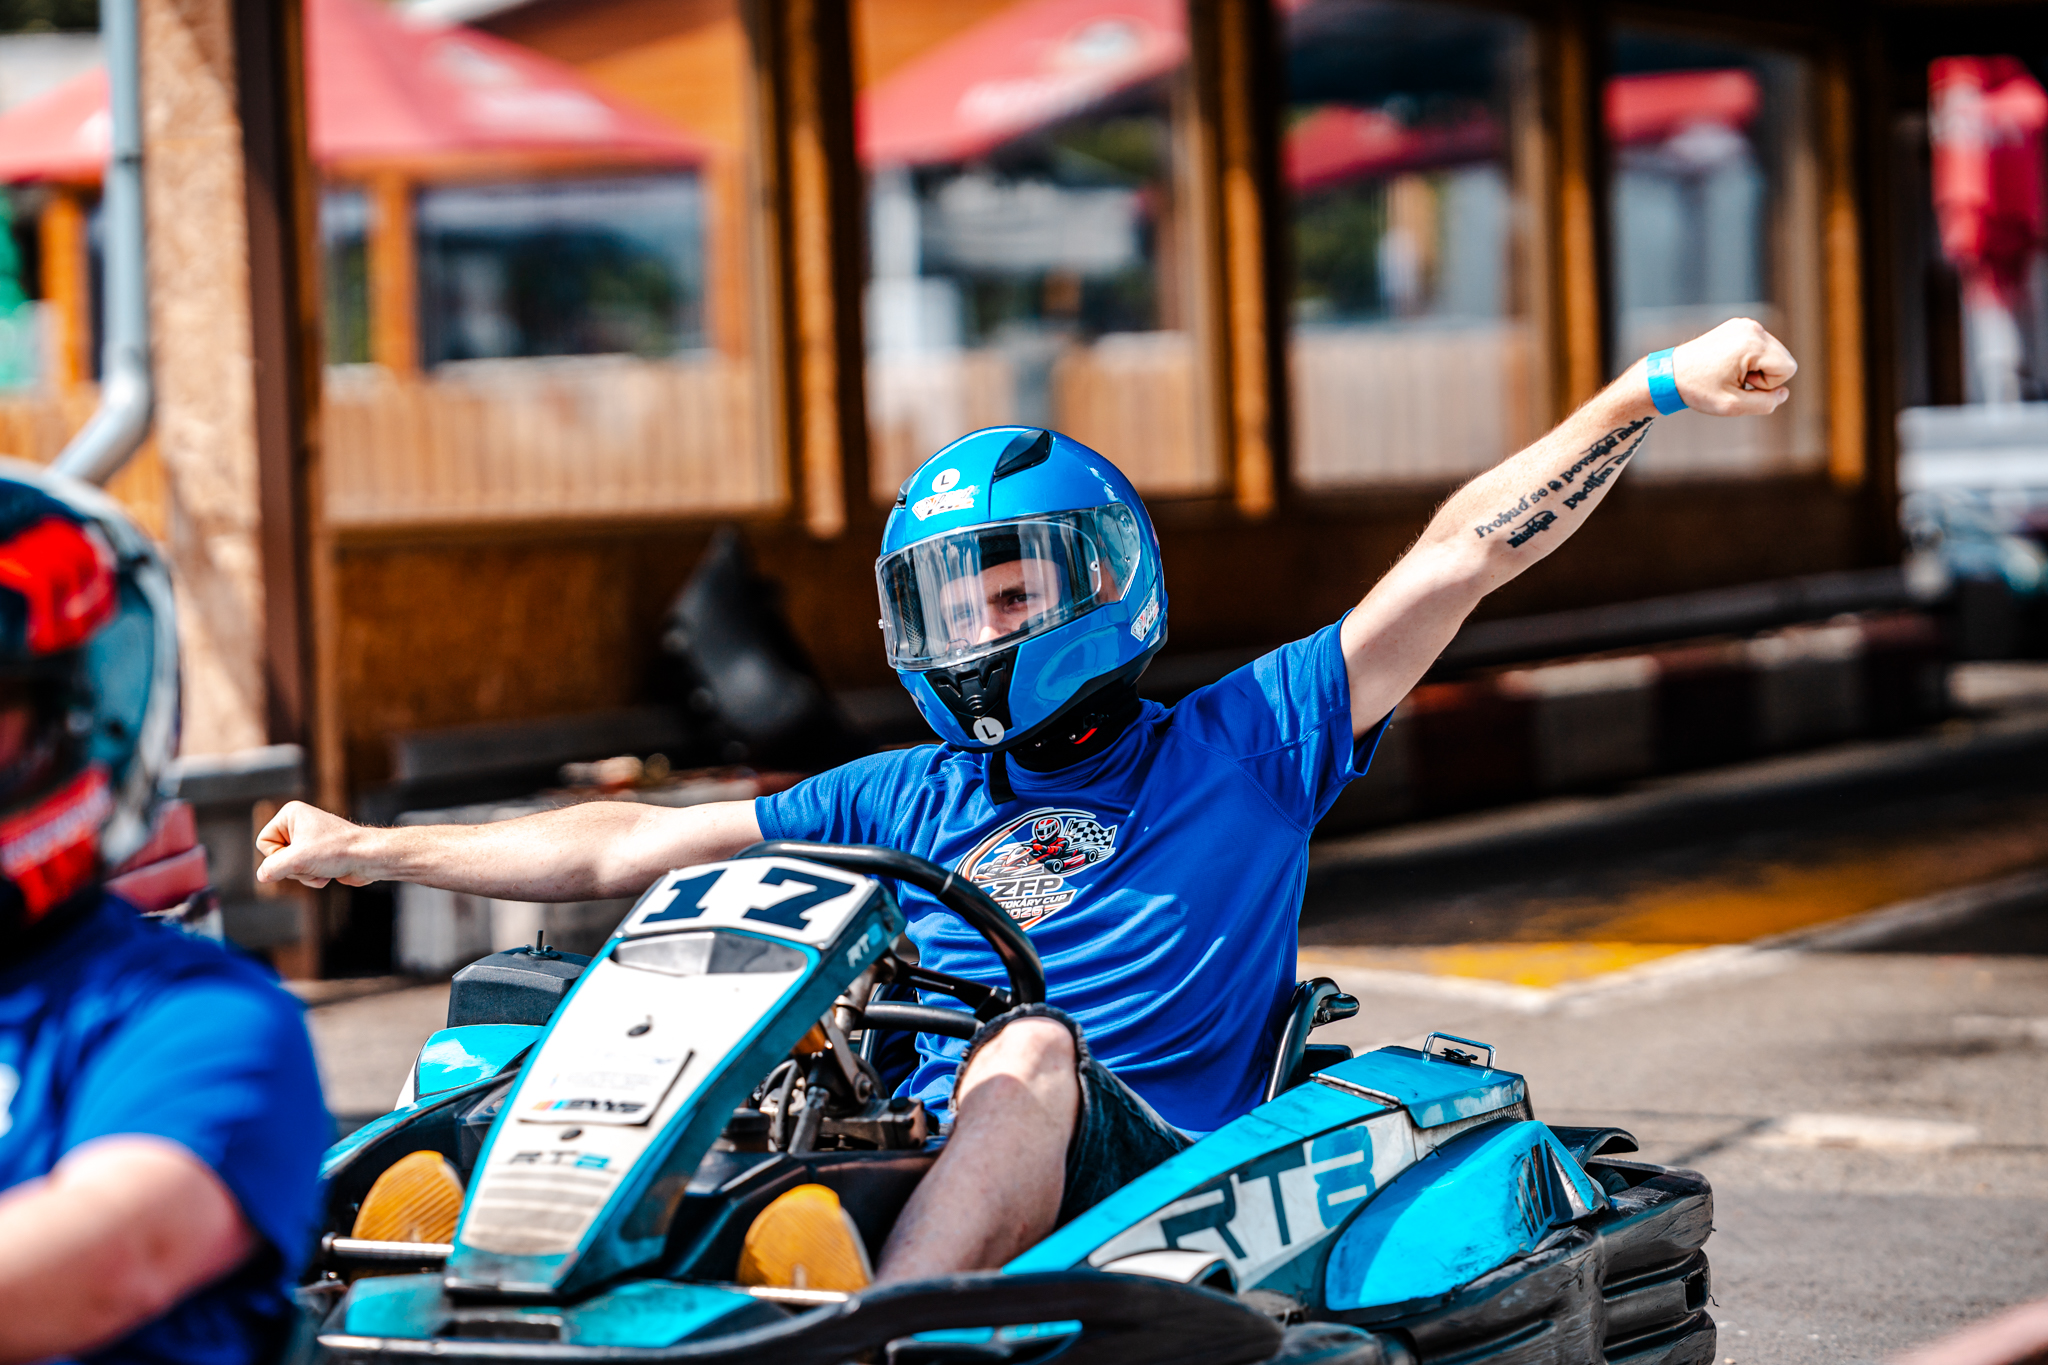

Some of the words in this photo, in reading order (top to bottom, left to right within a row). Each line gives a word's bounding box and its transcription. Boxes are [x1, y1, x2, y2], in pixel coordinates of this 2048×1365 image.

[940, 474, 950, 486] L
[1530, 488, 1549, 504] se
[981, 724, 997, 740] L
[993, 877, 1060, 898] ZFP
[640, 866, 855, 930] 17
[998, 896, 1042, 908] TOKÁRY
[1043, 894, 1067, 904] CUP
[1160, 1125, 1377, 1260] RT8
